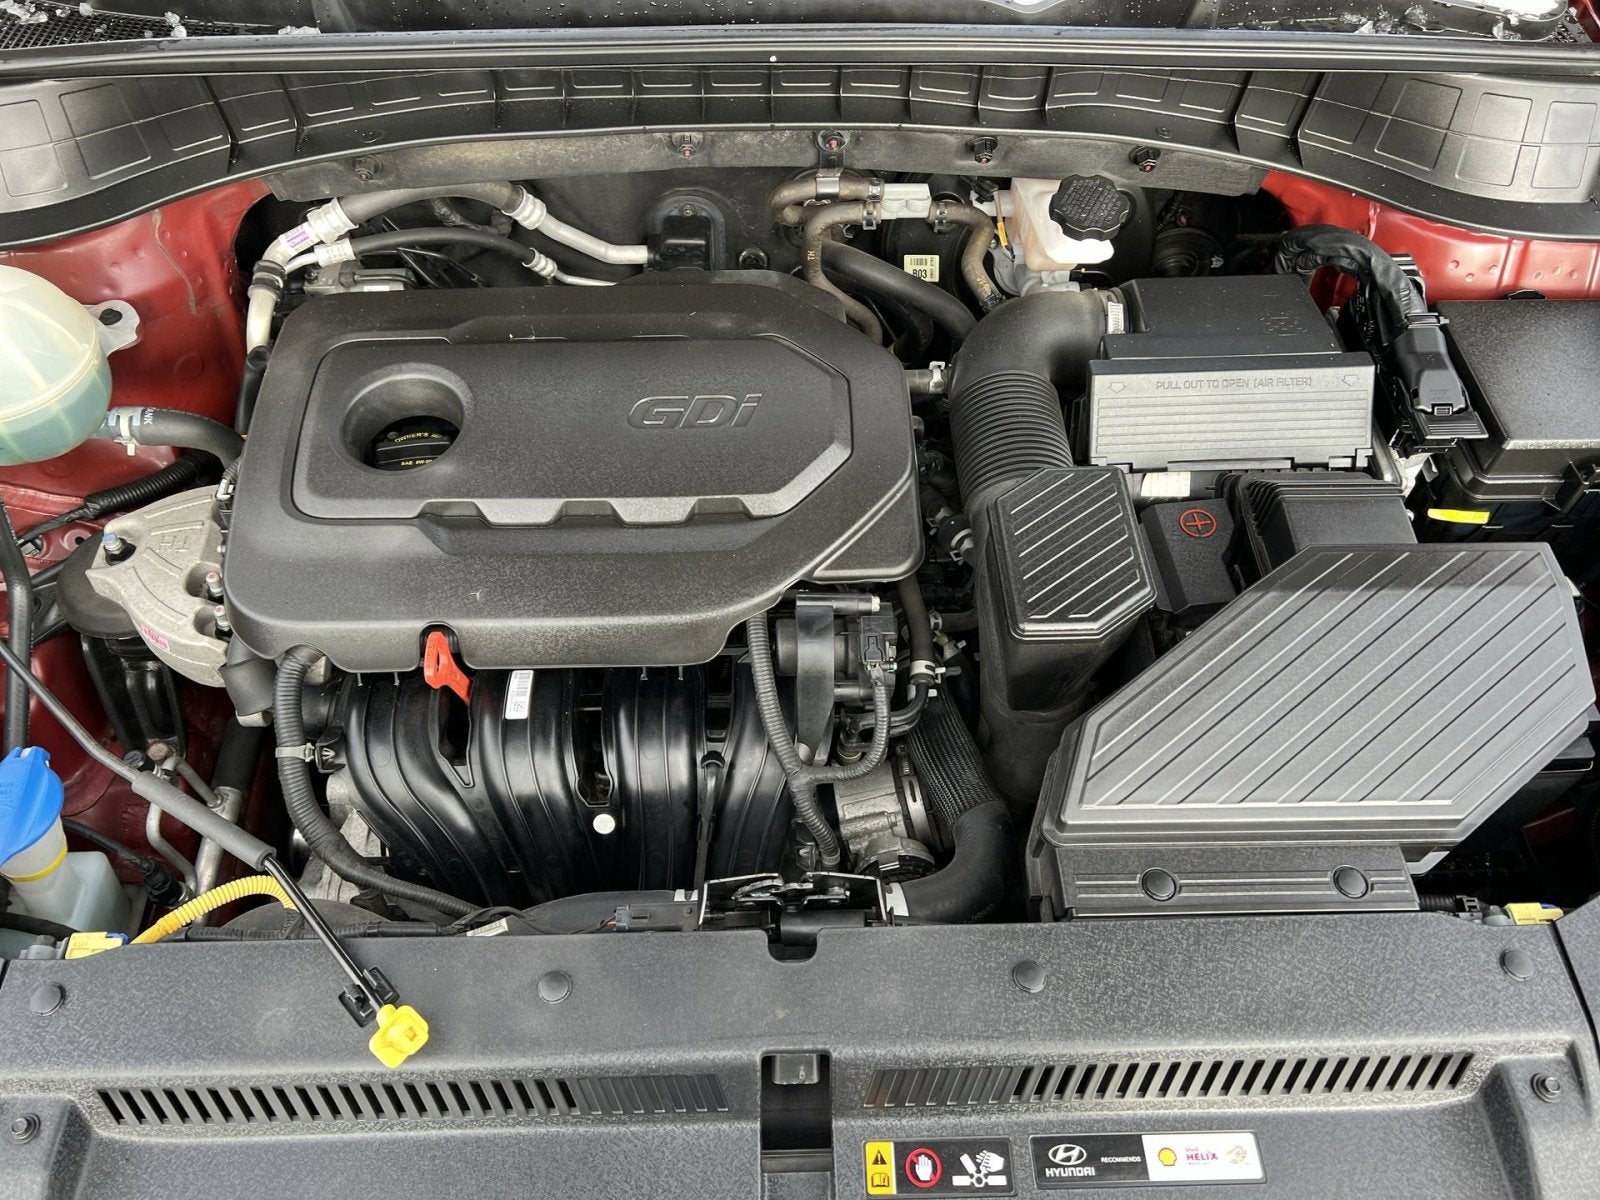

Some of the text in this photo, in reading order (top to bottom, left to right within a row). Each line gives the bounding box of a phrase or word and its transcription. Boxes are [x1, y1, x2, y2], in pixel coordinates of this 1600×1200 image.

[1156, 380, 1181, 390] PULL
[1183, 379, 1204, 390] OUT
[1206, 378, 1219, 389] TO
[1222, 377, 1249, 388] OPEN
[627, 393, 762, 429] GDi
[1100, 1155, 1142, 1164] RECOMMENDS
[1186, 1152, 1219, 1161] HELIX
[1045, 1167, 1095, 1177] HYUNDAI
